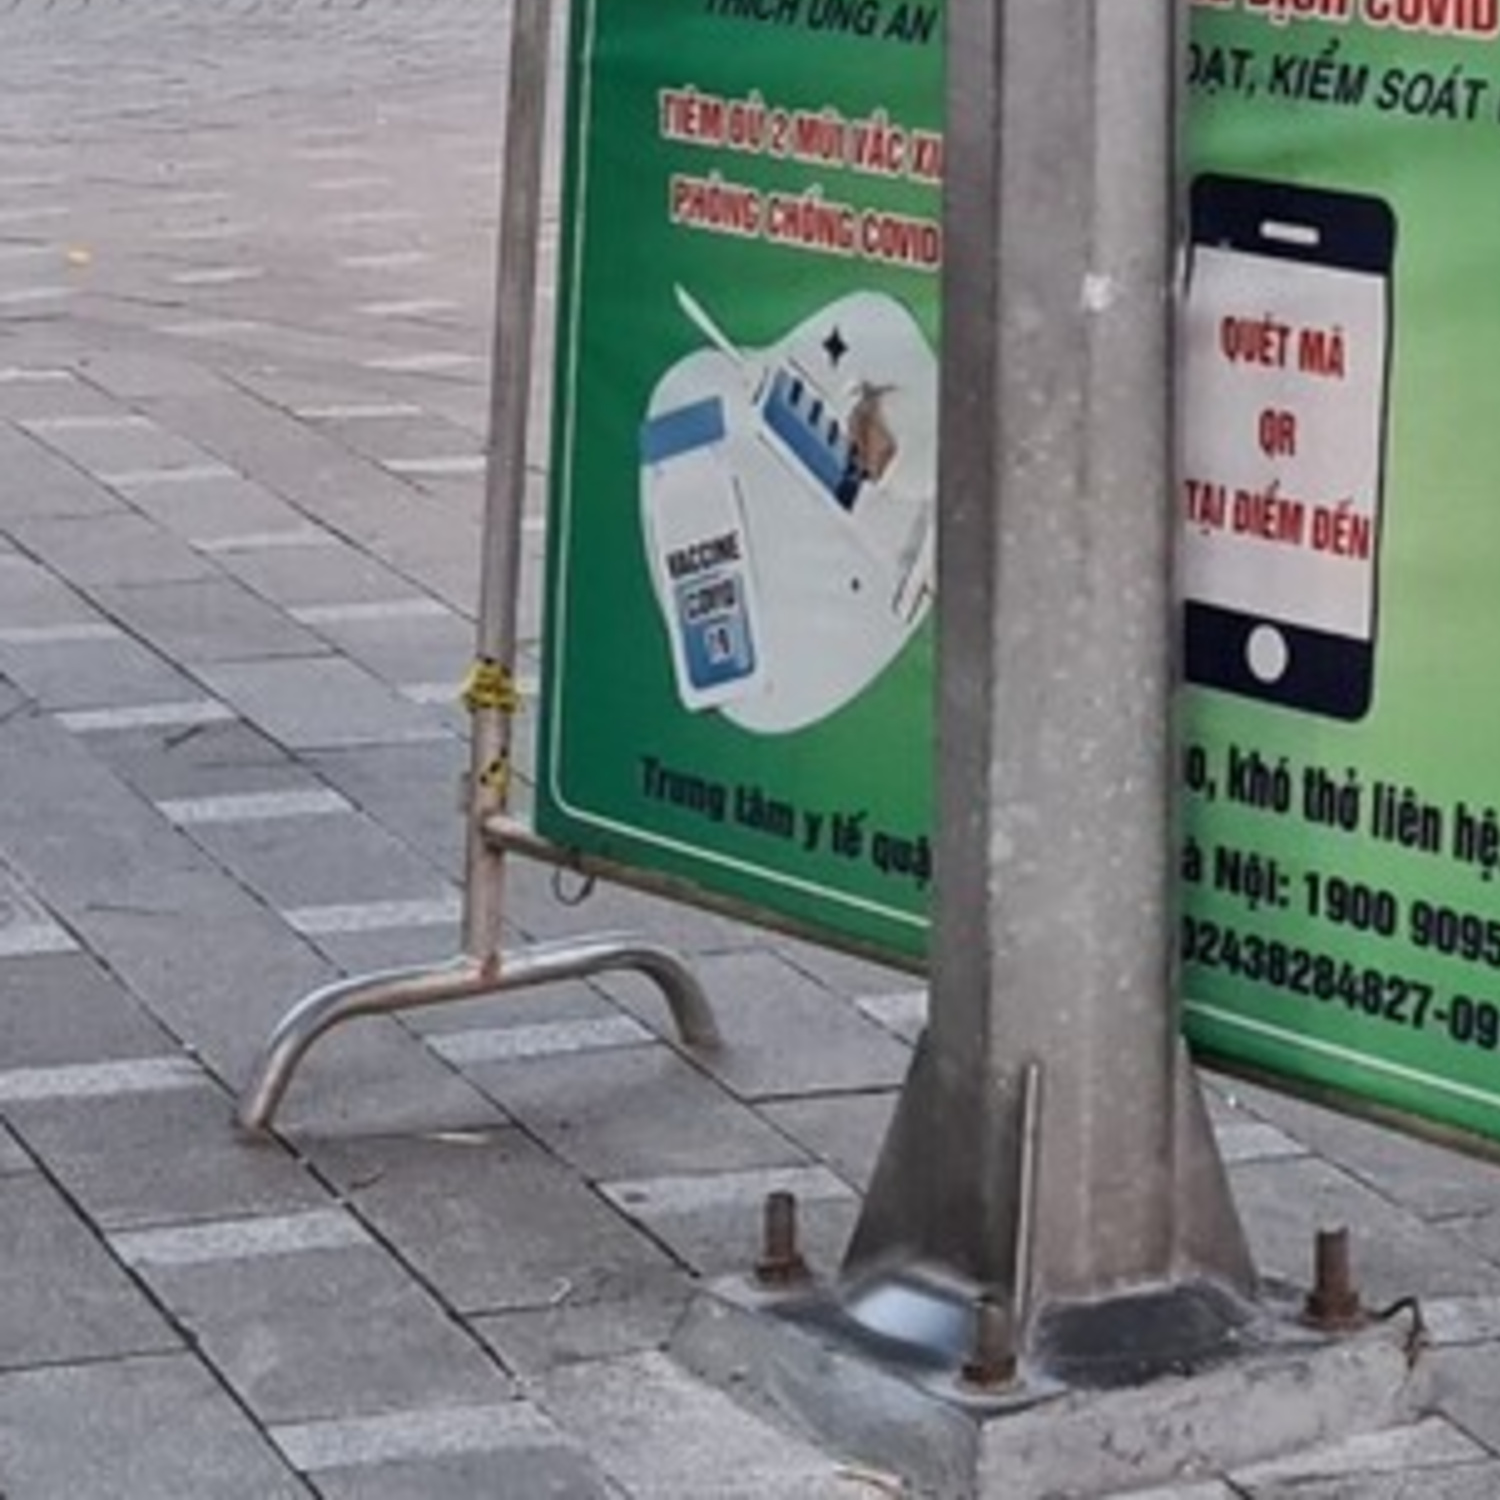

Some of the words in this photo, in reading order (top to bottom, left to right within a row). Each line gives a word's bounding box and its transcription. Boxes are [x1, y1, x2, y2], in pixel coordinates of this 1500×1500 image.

[884, 4, 938, 44] AN
[1268, 37, 1369, 107] KIỂM
[1375, 64, 1488, 120] SOÁT
[769, 106, 790, 159] 2
[1220, 312, 1290, 367] QUÉT
[1258, 409, 1296, 458] QR
[1185, 478, 1227, 536] TẠI
[666, 529, 741, 580] VACCINE
[640, 755, 728, 822] Trung
[802, 809, 824, 851] y
[1227, 742, 1291, 814] khó
[1302, 766, 1362, 833] thở
[1371, 781, 1442, 855] liên
[1214, 845, 1290, 911] Nội:
[1303, 871, 1397, 938] 1900
